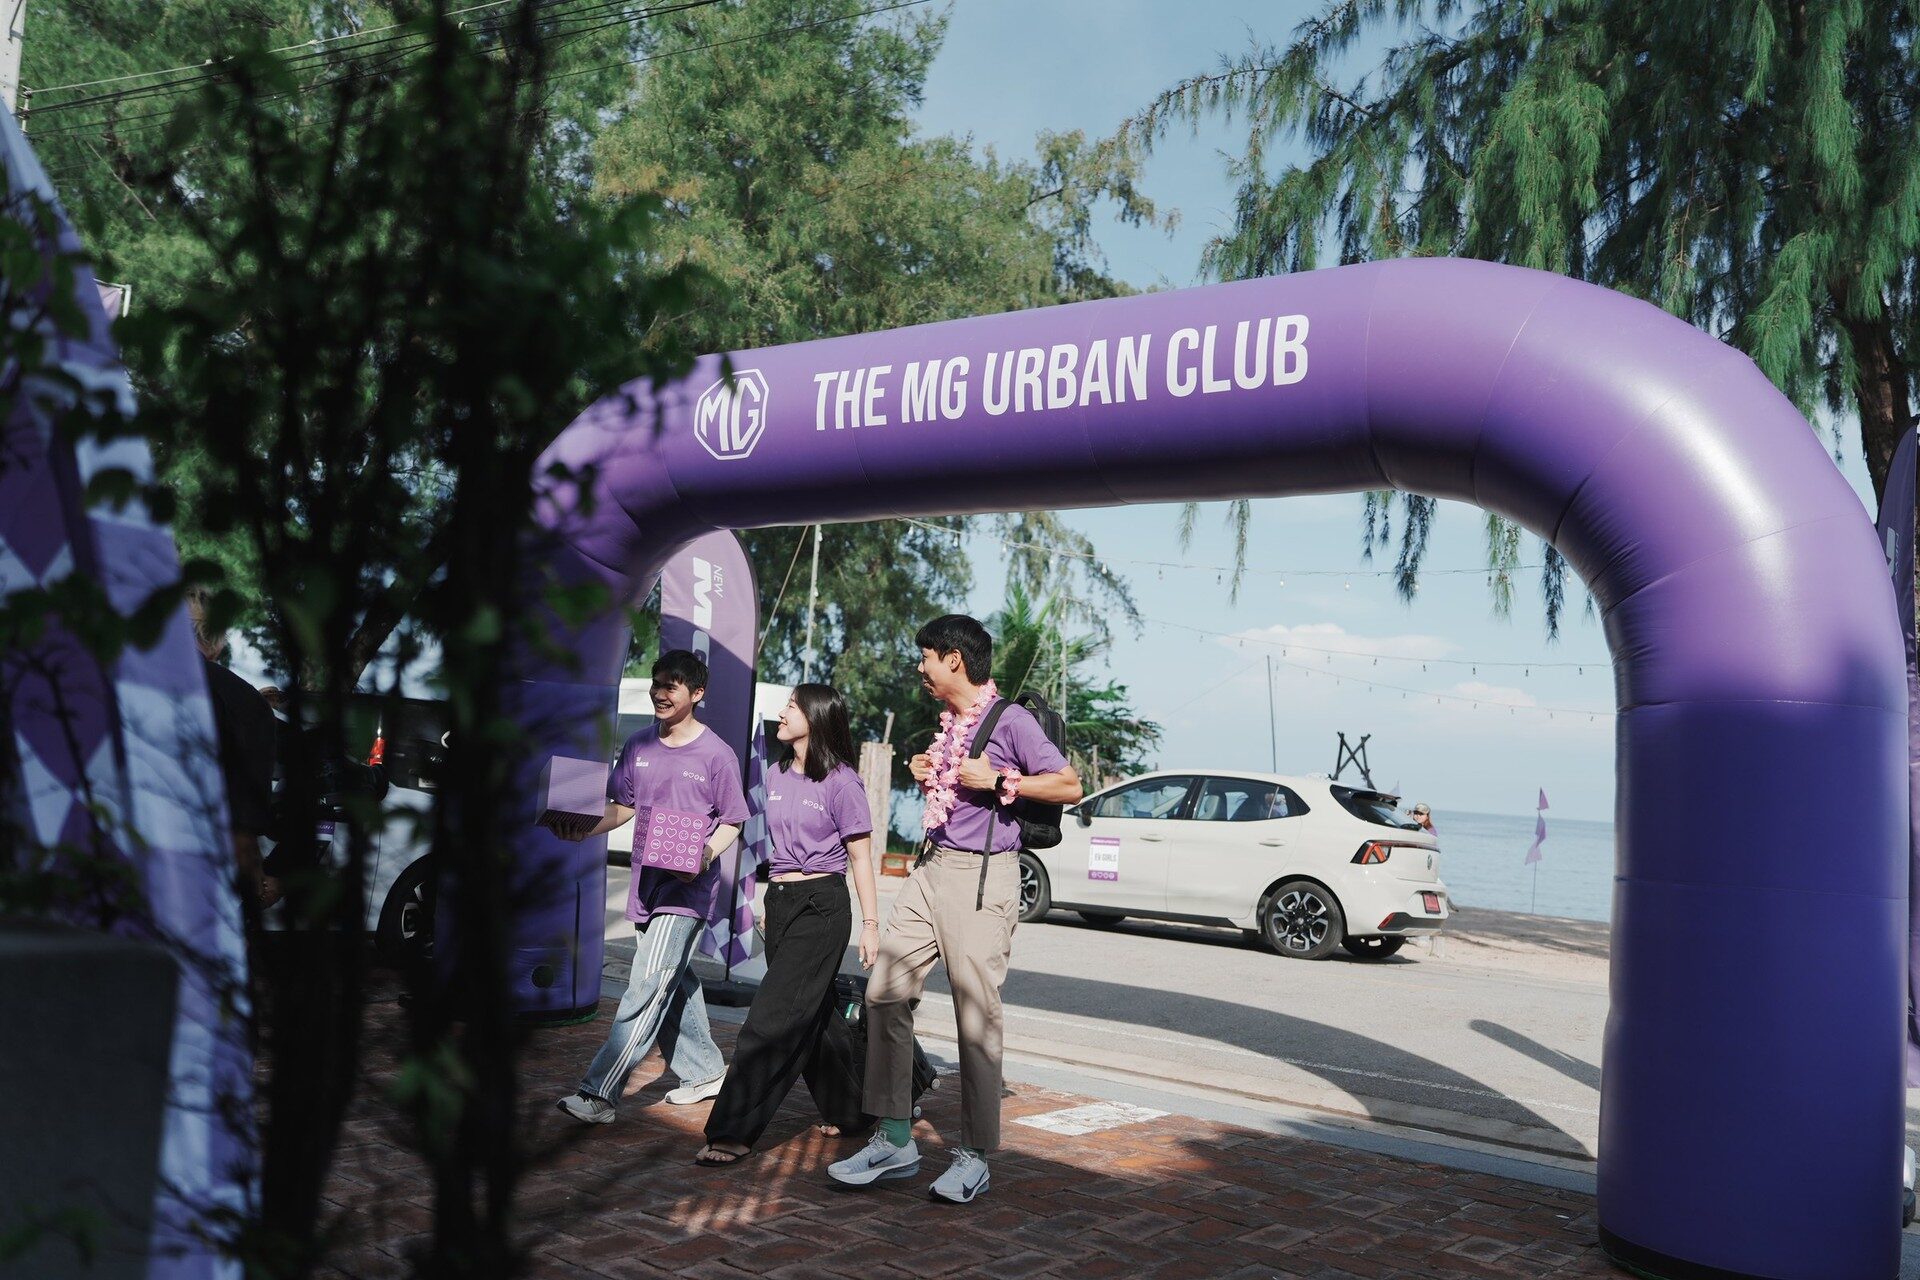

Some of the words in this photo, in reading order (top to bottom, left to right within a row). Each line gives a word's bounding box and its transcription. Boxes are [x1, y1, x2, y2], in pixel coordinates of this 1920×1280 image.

[813, 364, 892, 431] THE
[901, 356, 970, 424] MG
[983, 333, 1152, 416] URBAN
[1166, 313, 1309, 398] CLUB
[700, 376, 761, 452] MG
[713, 564, 724, 598] NEW
